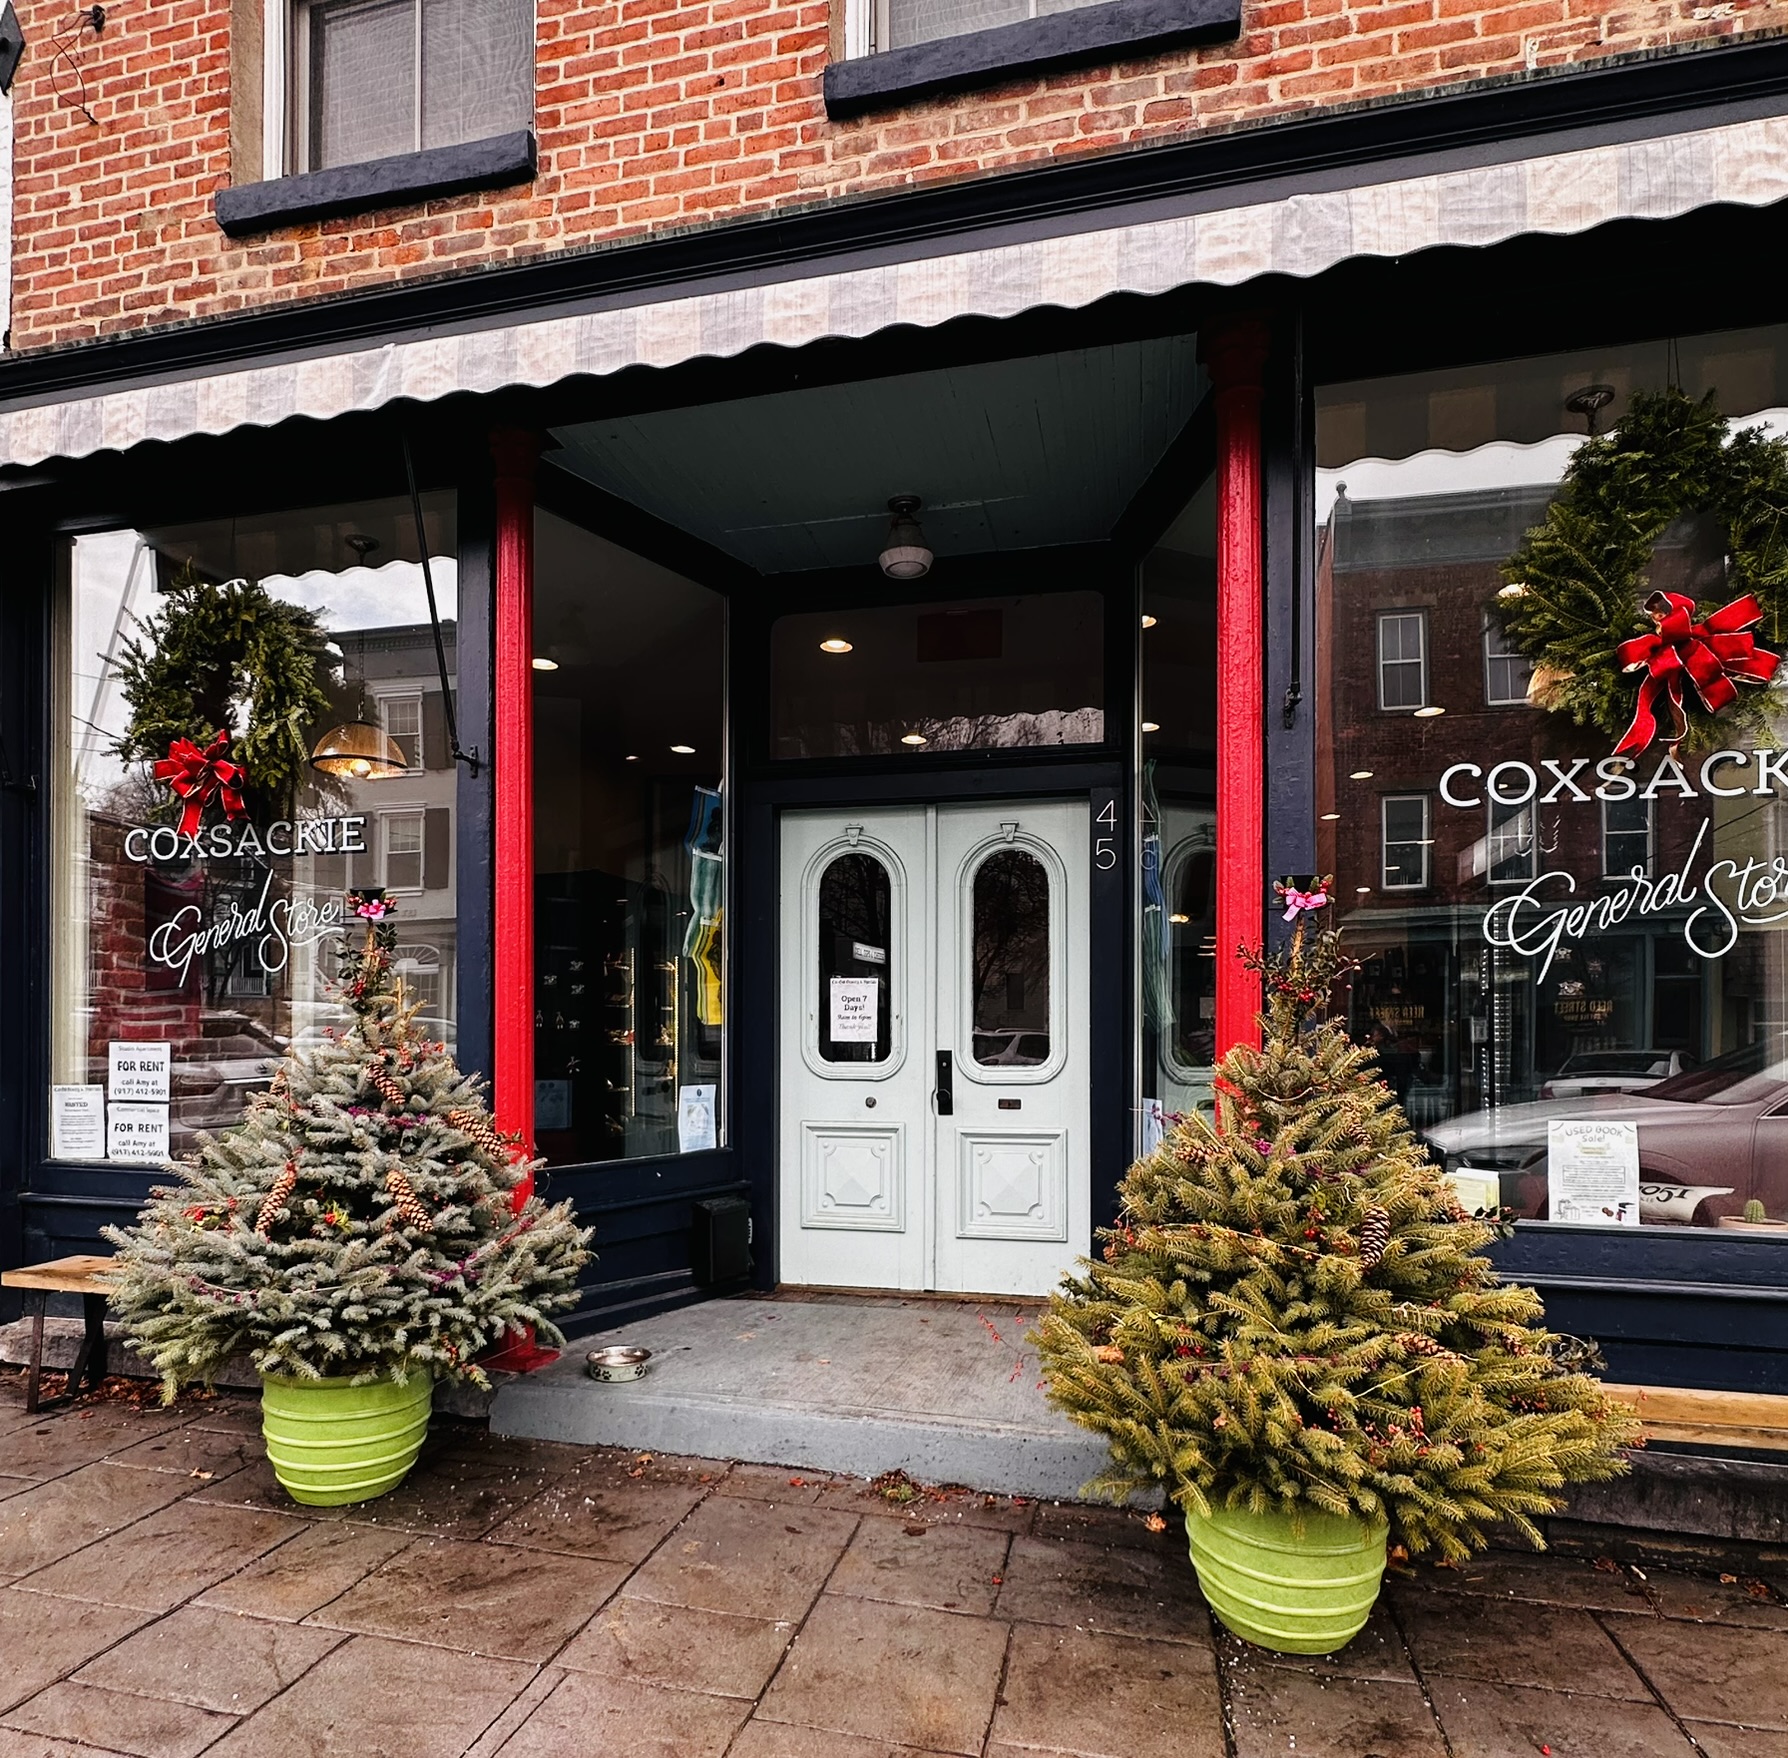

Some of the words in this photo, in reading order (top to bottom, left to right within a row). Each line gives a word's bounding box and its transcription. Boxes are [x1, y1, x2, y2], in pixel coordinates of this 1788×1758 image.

[1439, 749, 1788, 807] COXSACK
[124, 816, 366, 862] COXSACKIE
[1483, 817, 1709, 985] General
[150, 868, 274, 988] General
[258, 897, 345, 973] Store
[841, 995, 861, 1004] Open
[117, 1060, 137, 1072] FOR
[139, 1060, 165, 1072] RENT
[136, 1079, 149, 1087] Amy
[114, 1122, 134, 1133] FOR
[138, 1123, 163, 1133] RENT
[1565, 1126, 1593, 1137] USED
[1595, 1126, 1623, 1137] BOOK
[132, 1140, 147, 1148] Amy
[1582, 1134, 1606, 1143] Sale!
